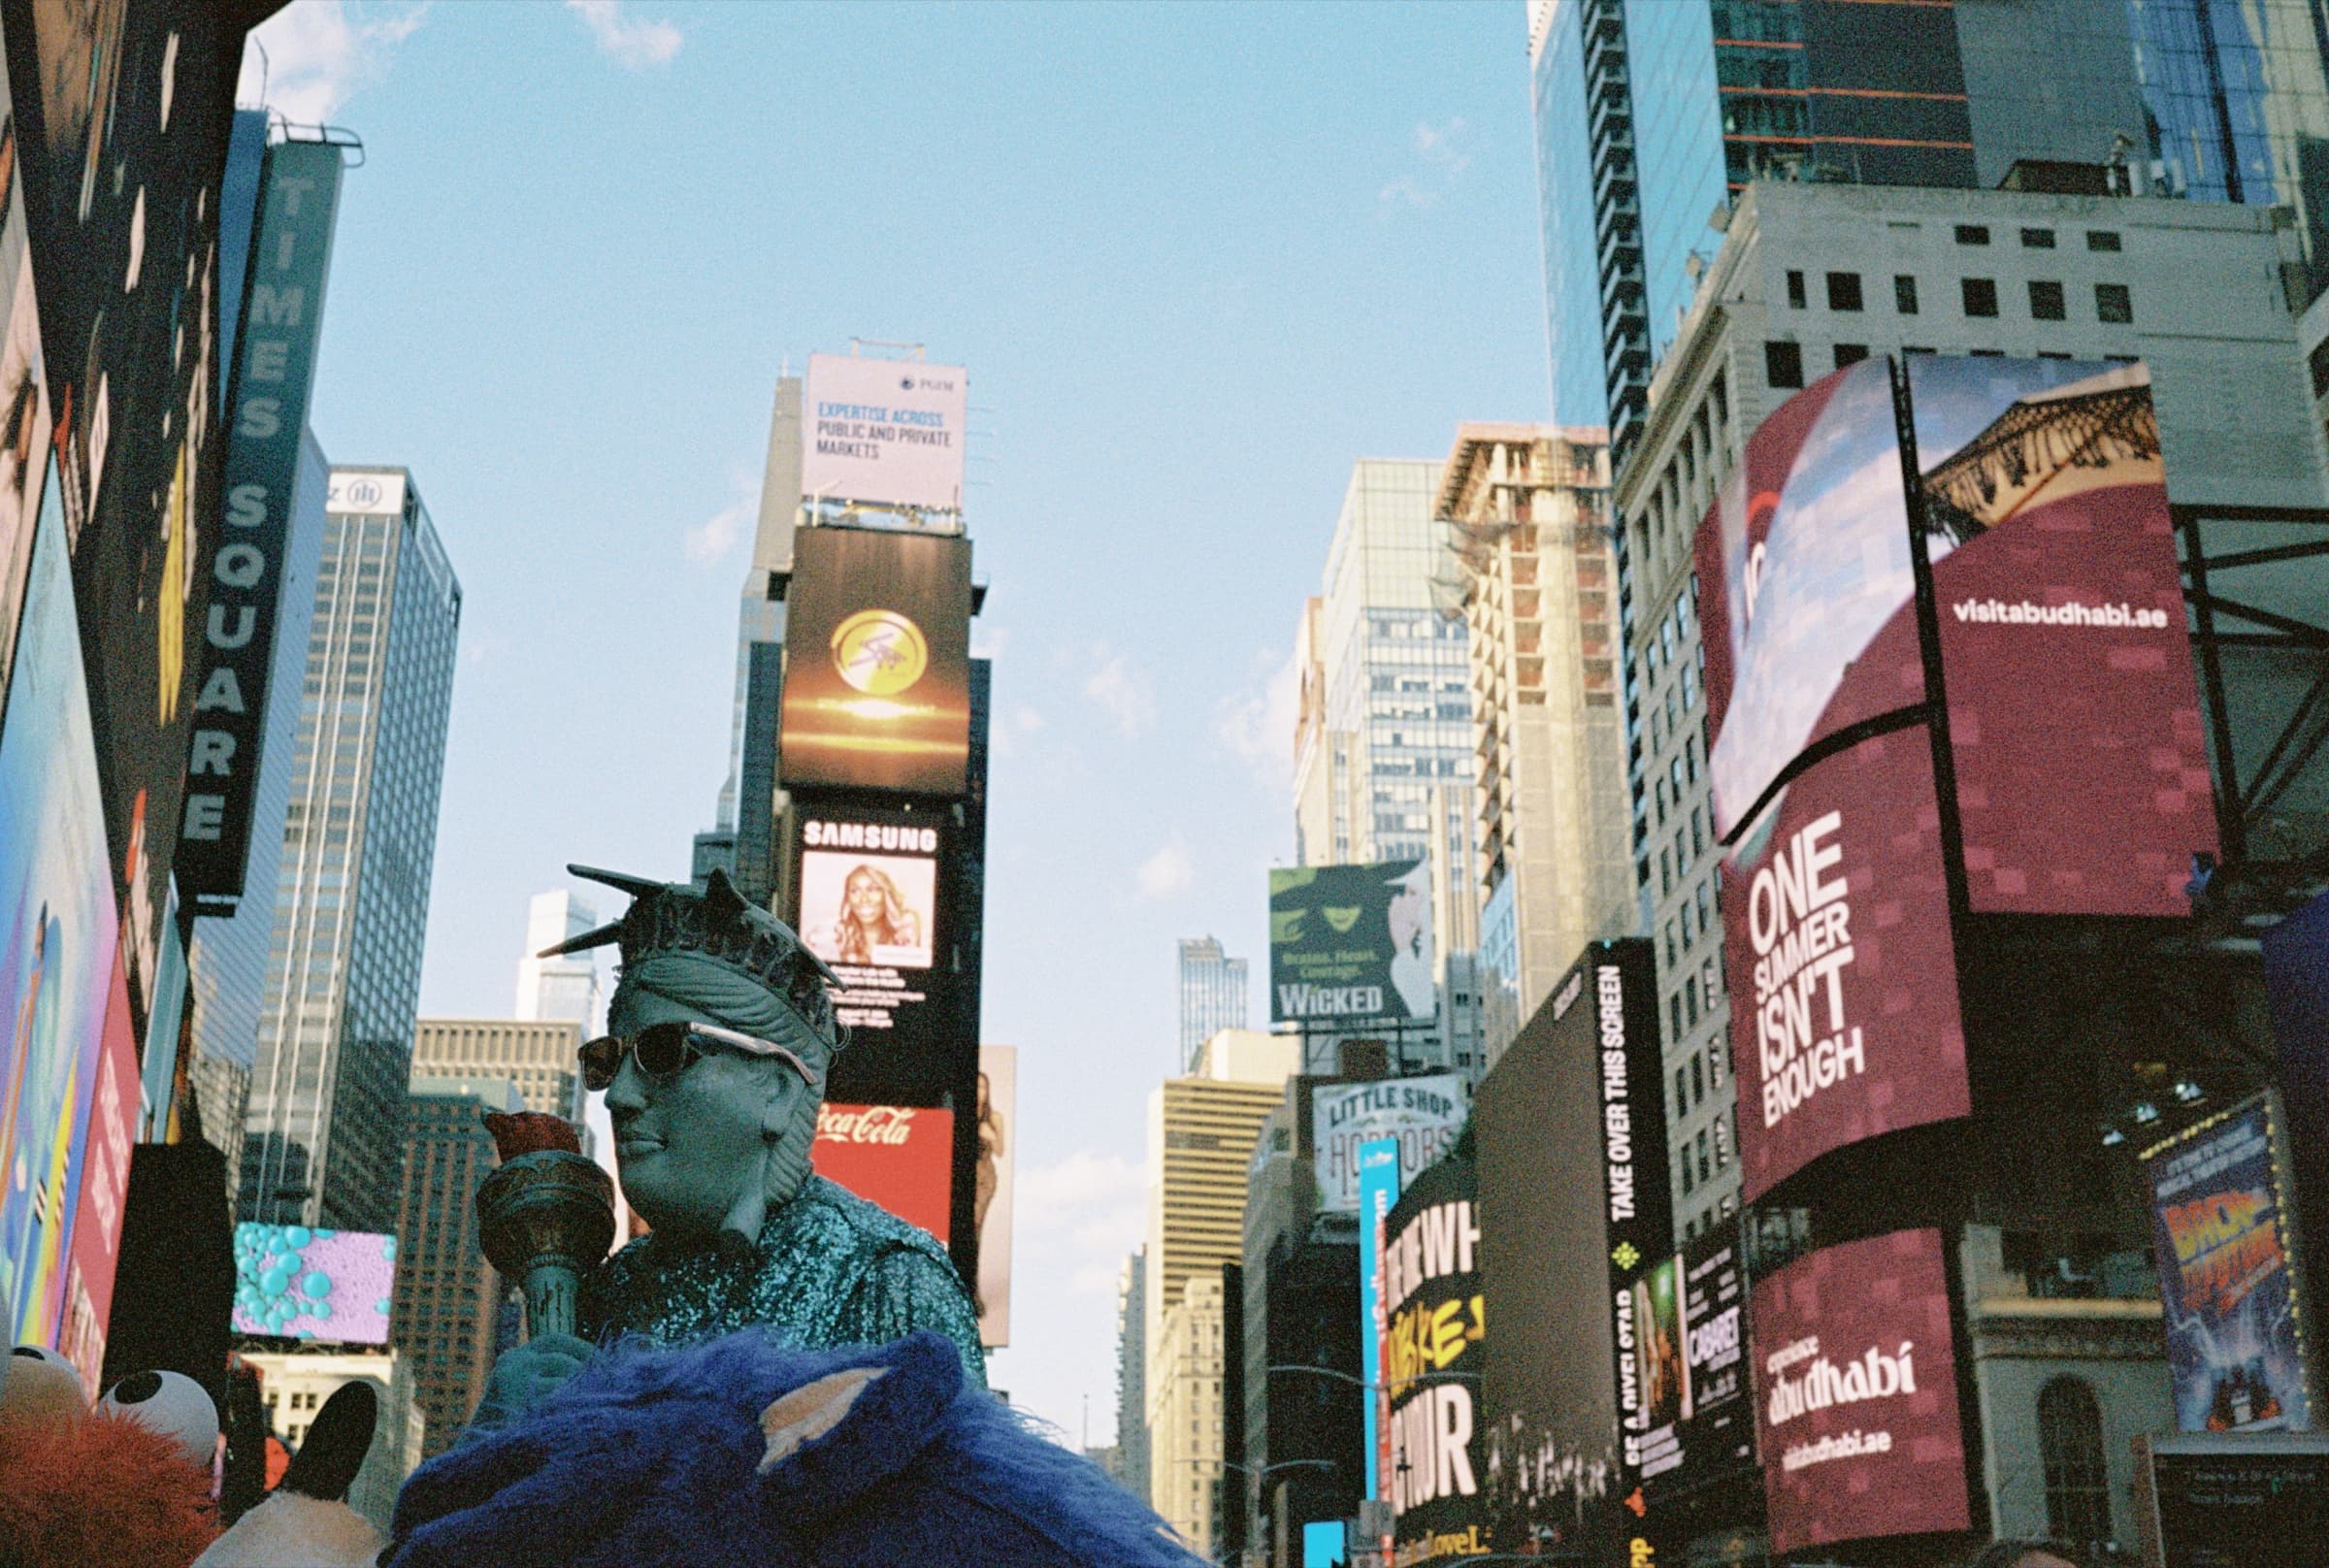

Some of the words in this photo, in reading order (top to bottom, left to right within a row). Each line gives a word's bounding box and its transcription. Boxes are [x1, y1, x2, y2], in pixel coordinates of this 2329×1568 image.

[243, 177, 314, 438] TIMES
[817, 421, 866, 440] PUBLIC
[869, 426, 896, 441] AND
[899, 428, 953, 447] PRIVATE
[818, 402, 888, 422] EXPERTISE
[892, 408, 944, 427] ACROSS
[816, 440, 879, 460] MARKETS
[1952, 598, 2168, 628] visitabudhabi.ae
[182, 485, 268, 840] SQUARE
[804, 821, 936, 852] SAMSUNG
[1749, 810, 1849, 955] ONE
[1754, 900, 1852, 1004] SUMMER
[1598, 964, 1625, 1049] SCREEN
[1756, 945, 1854, 1082] ISN'T
[1602, 1050, 1627, 1101] THIS
[1762, 1026, 1865, 1128] ENOUGH
[1330, 1087, 1396, 1127] LITTLE
[1403, 1088, 1453, 1118] SHOP
[1606, 1103, 1632, 1161] OVER
[1609, 1164, 1634, 1222] TAKE
